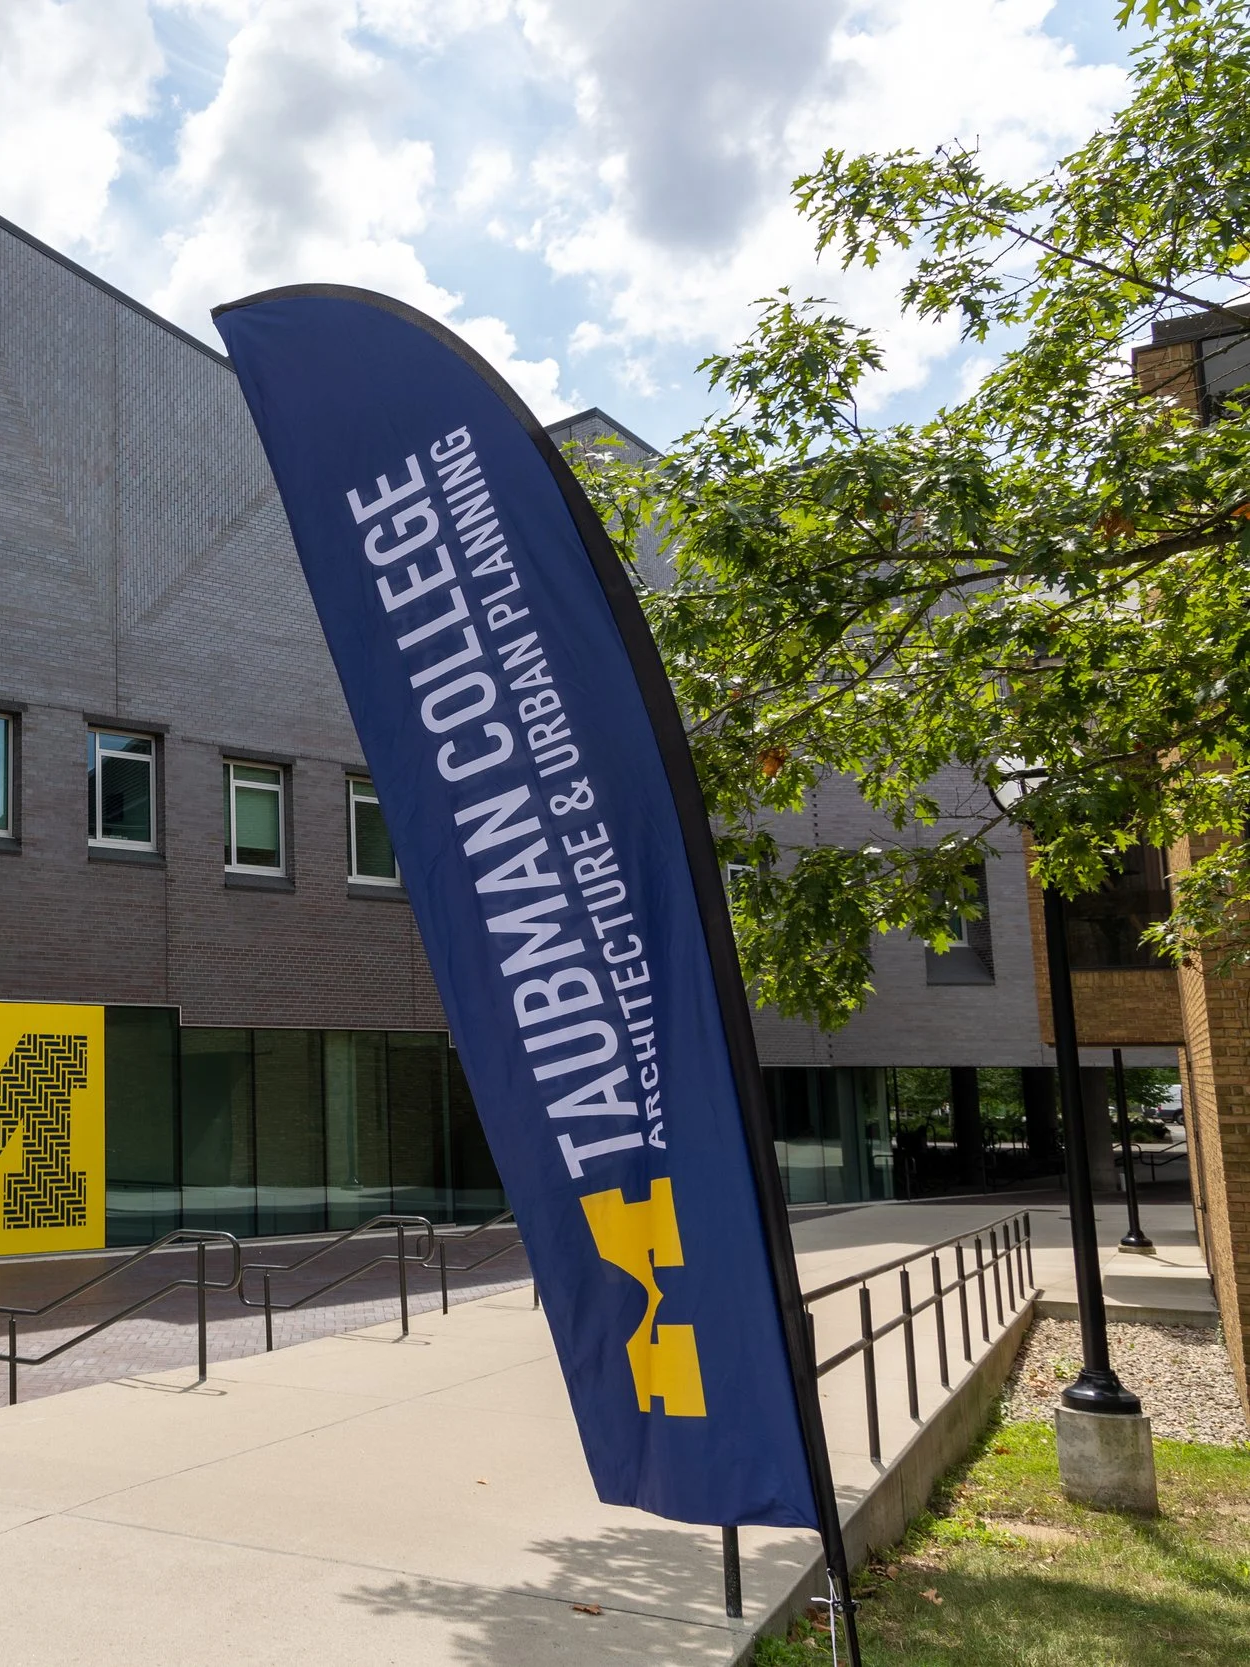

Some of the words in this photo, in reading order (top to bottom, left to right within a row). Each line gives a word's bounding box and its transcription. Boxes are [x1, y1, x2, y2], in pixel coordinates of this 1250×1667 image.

[347, 454, 513, 781] COLLEGE
[431, 426, 529, 631] PLANNING
[498, 632, 579, 777] URBAN
[550, 777, 594, 815] &
[455, 785, 643, 1178] TAUBMAN
[562, 823, 667, 1148] ARCHITECTURE
[581, 1178, 706, 1417] M
